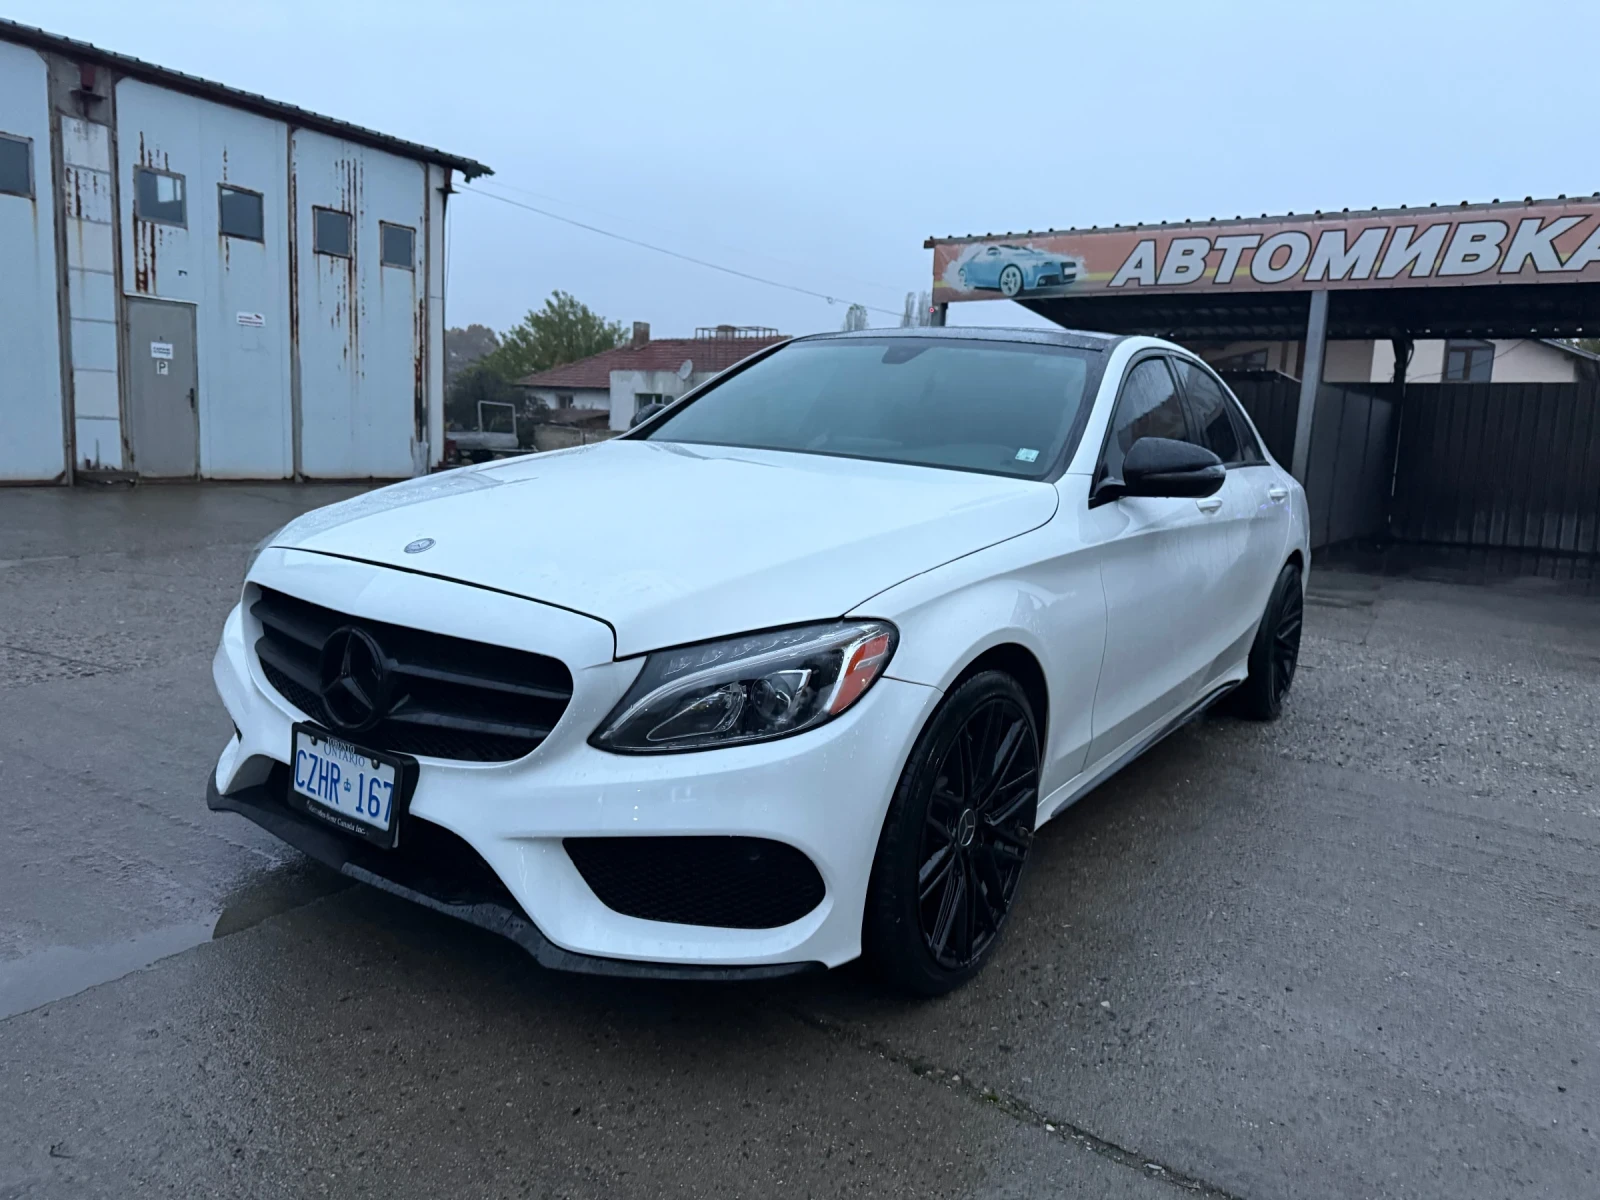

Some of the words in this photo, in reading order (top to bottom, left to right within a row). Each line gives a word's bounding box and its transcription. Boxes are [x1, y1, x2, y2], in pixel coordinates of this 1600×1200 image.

[324, 742, 365, 767] ONTARIO
[295, 749, 341, 805] CZHR
[355, 772, 394, 823] 167
[337, 817, 355, 831] Canada
